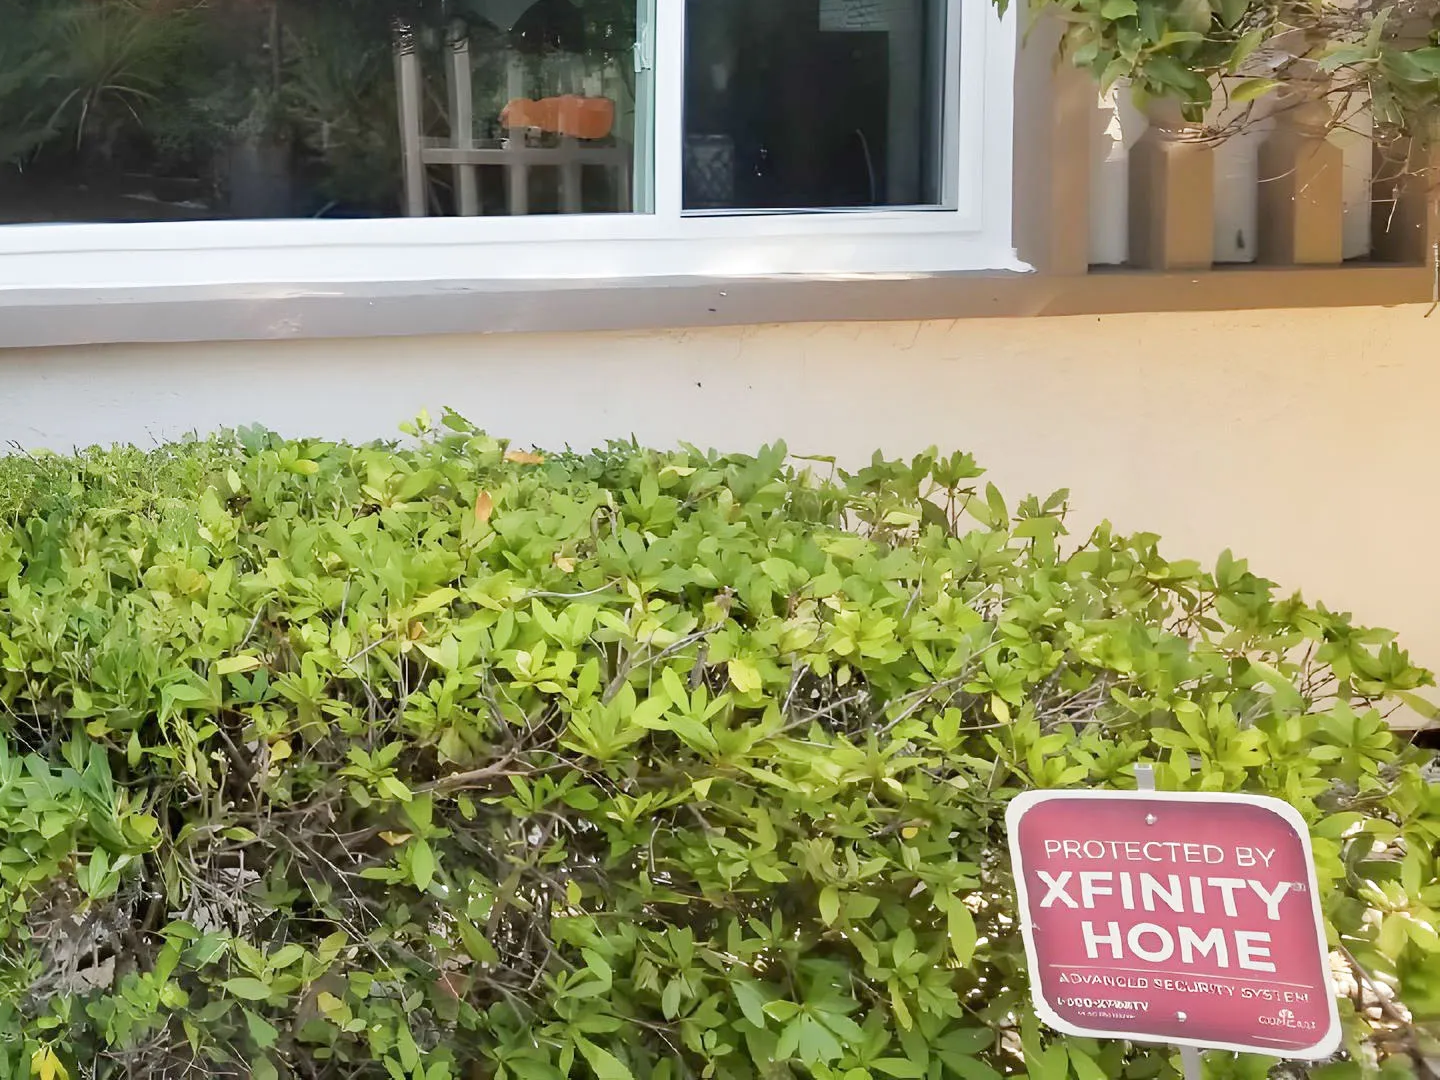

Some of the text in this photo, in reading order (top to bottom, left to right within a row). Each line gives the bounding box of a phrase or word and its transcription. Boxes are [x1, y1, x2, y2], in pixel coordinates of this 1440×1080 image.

[1044, 839, 1276, 868] PROTECTED BY
[1035, 870, 1292, 921] XFINITY
[1081, 921, 1277, 973] HOME
[1059, 973, 1310, 1004] ADVANCED SECURITY SYSTEM
